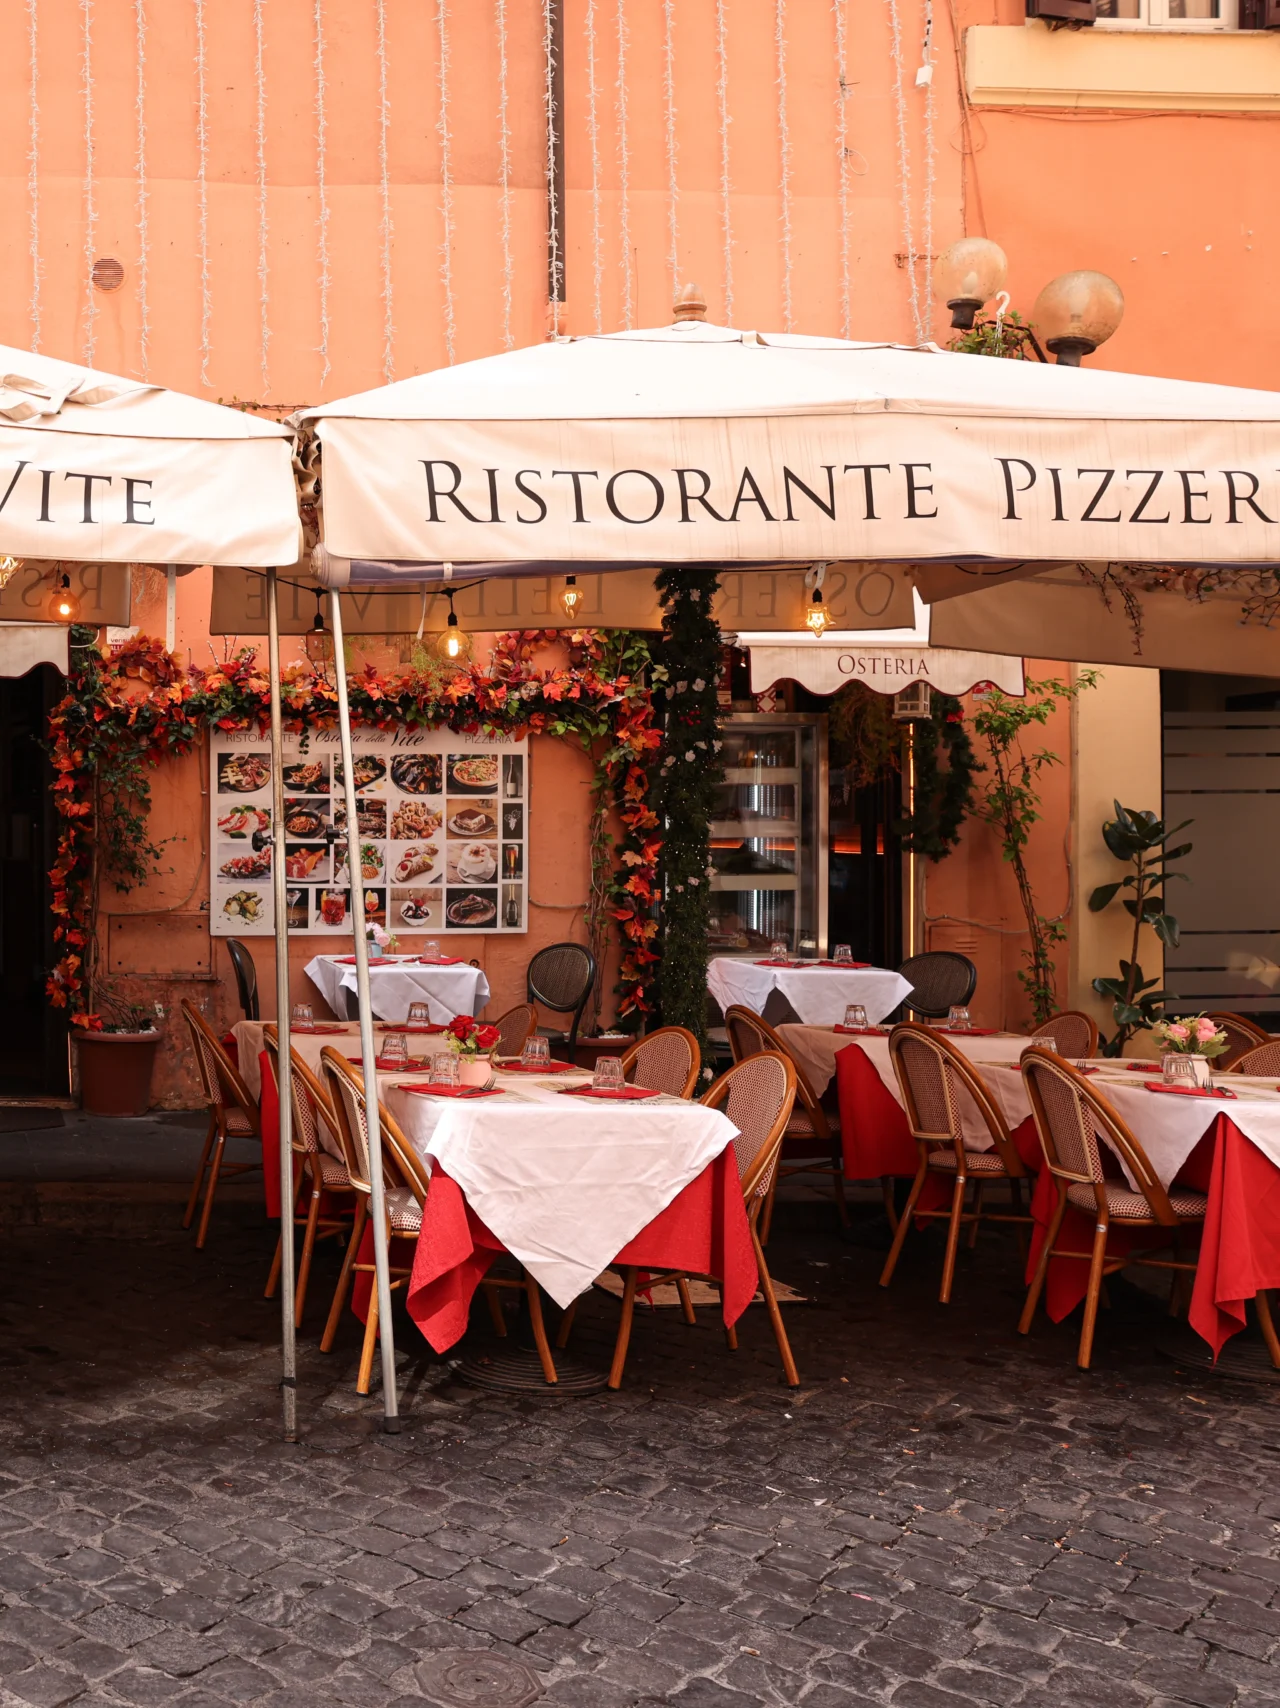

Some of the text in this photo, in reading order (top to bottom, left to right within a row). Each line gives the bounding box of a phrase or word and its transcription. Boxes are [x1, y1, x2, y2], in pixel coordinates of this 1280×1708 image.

[417, 457, 1280, 524] RISTORANTE PIZZER
[837, 654, 930, 676] OSTERIA
[226, 733, 294, 743] RISTORATE
[315, 730, 362, 743] Osteia
